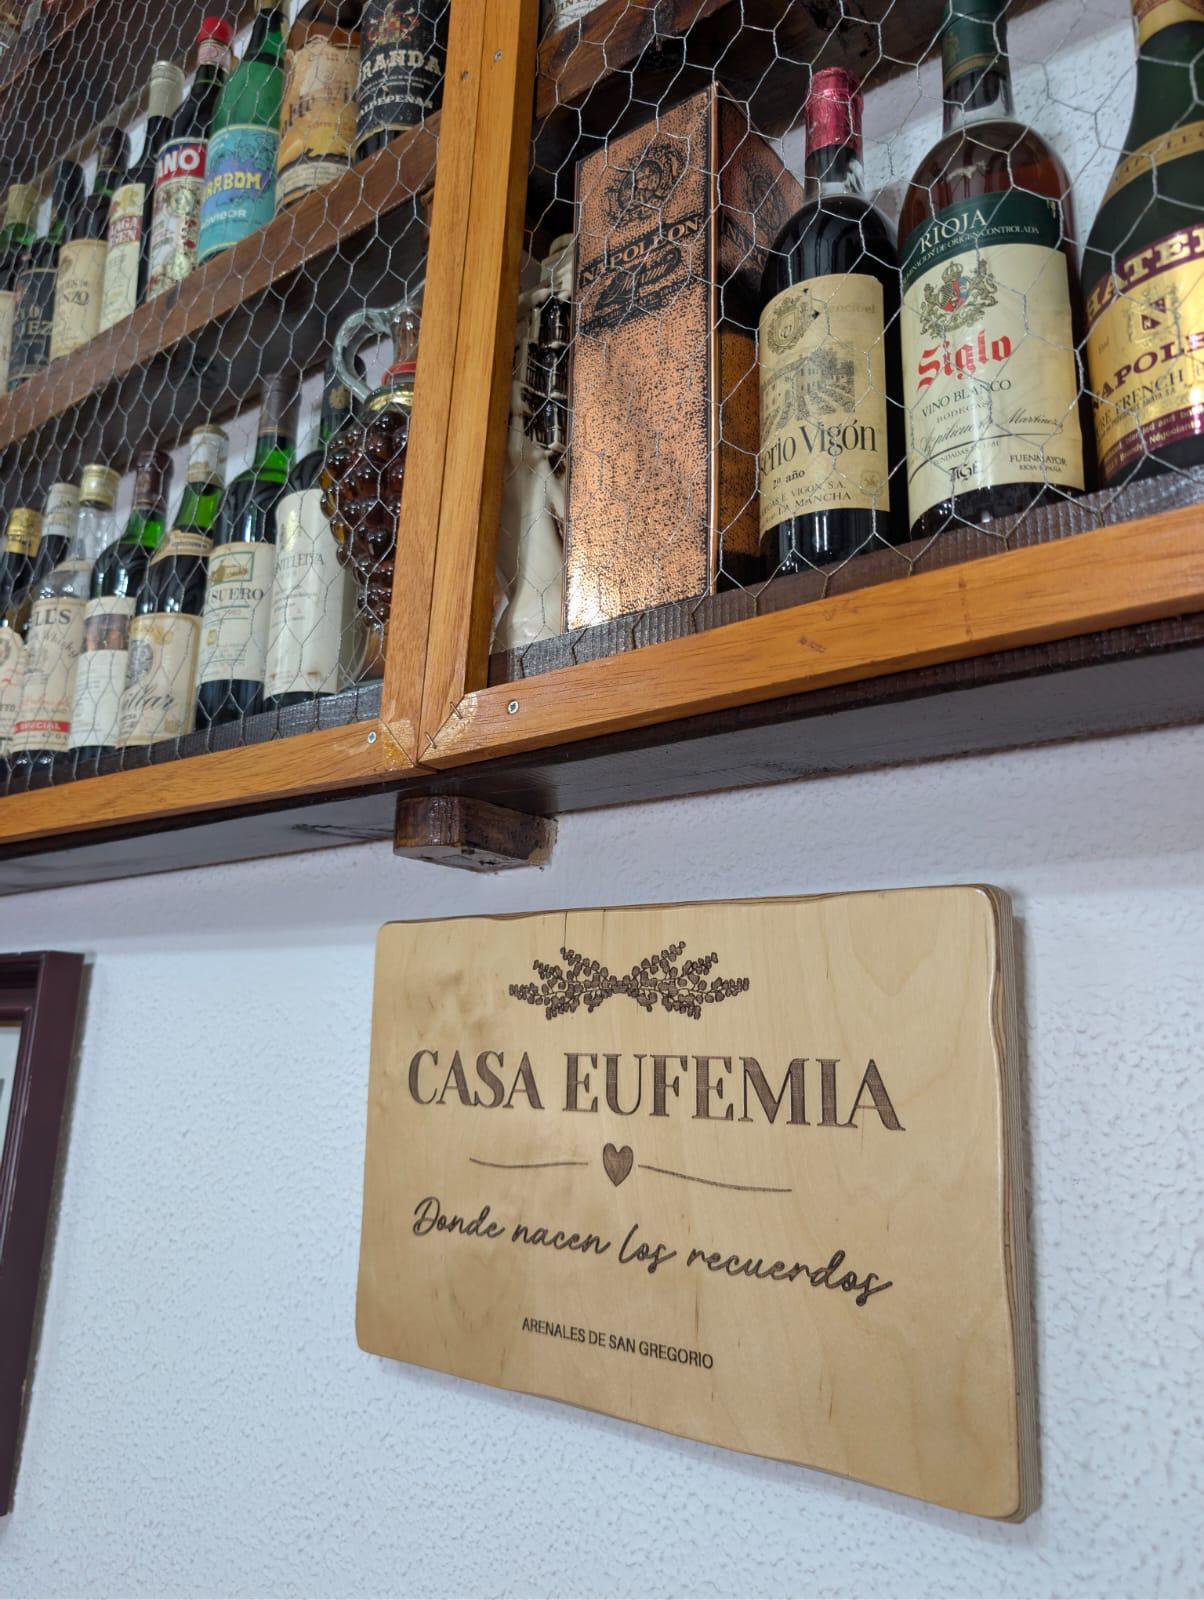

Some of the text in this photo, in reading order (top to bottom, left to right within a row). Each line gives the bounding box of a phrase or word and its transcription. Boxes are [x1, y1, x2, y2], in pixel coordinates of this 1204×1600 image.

[920, 208, 987, 253] RIOJA
[917, 328, 1012, 391] Siglo
[921, 380, 1012, 417] VINO BLANCO
[800, 419, 877, 457] Vigón
[786, 469, 806, 484] año
[828, 479, 847, 490] S.A.
[795, 491, 852, 508] MANCHA
[408, 1049, 906, 1132] CASA EUFEMIA
[412, 1196, 892, 1307] Donde nacen los recuerdos
[522, 1317, 714, 1370] ARENALES DE SAN GREGORIO
